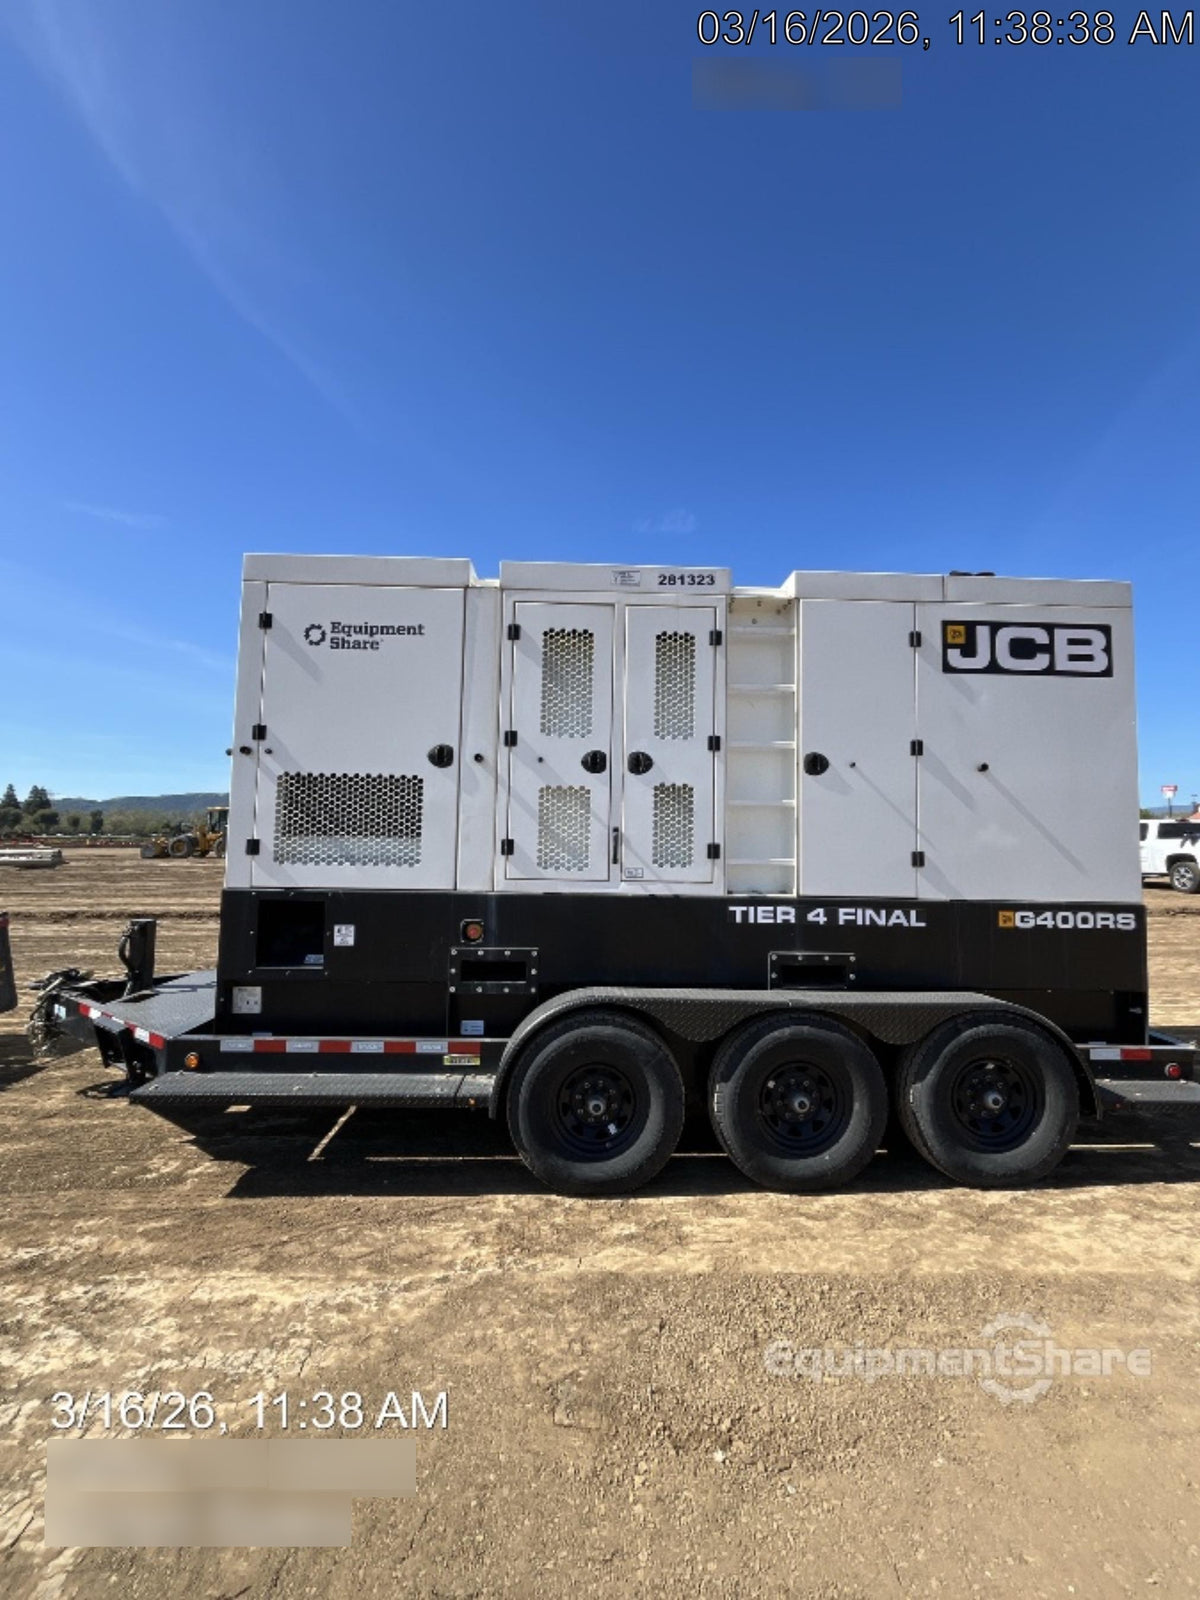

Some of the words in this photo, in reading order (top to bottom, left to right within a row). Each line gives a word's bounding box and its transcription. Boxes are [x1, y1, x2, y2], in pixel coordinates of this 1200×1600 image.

[658, 574, 715, 586] 281323
[330, 621, 425, 637] Equipment
[330, 637, 380, 650] Share
[947, 625, 1108, 673] JCB
[728, 906, 796, 924] TIER
[806, 907, 828, 925] 4
[838, 907, 927, 927] FINAL
[1015, 911, 1136, 931] G400RS
